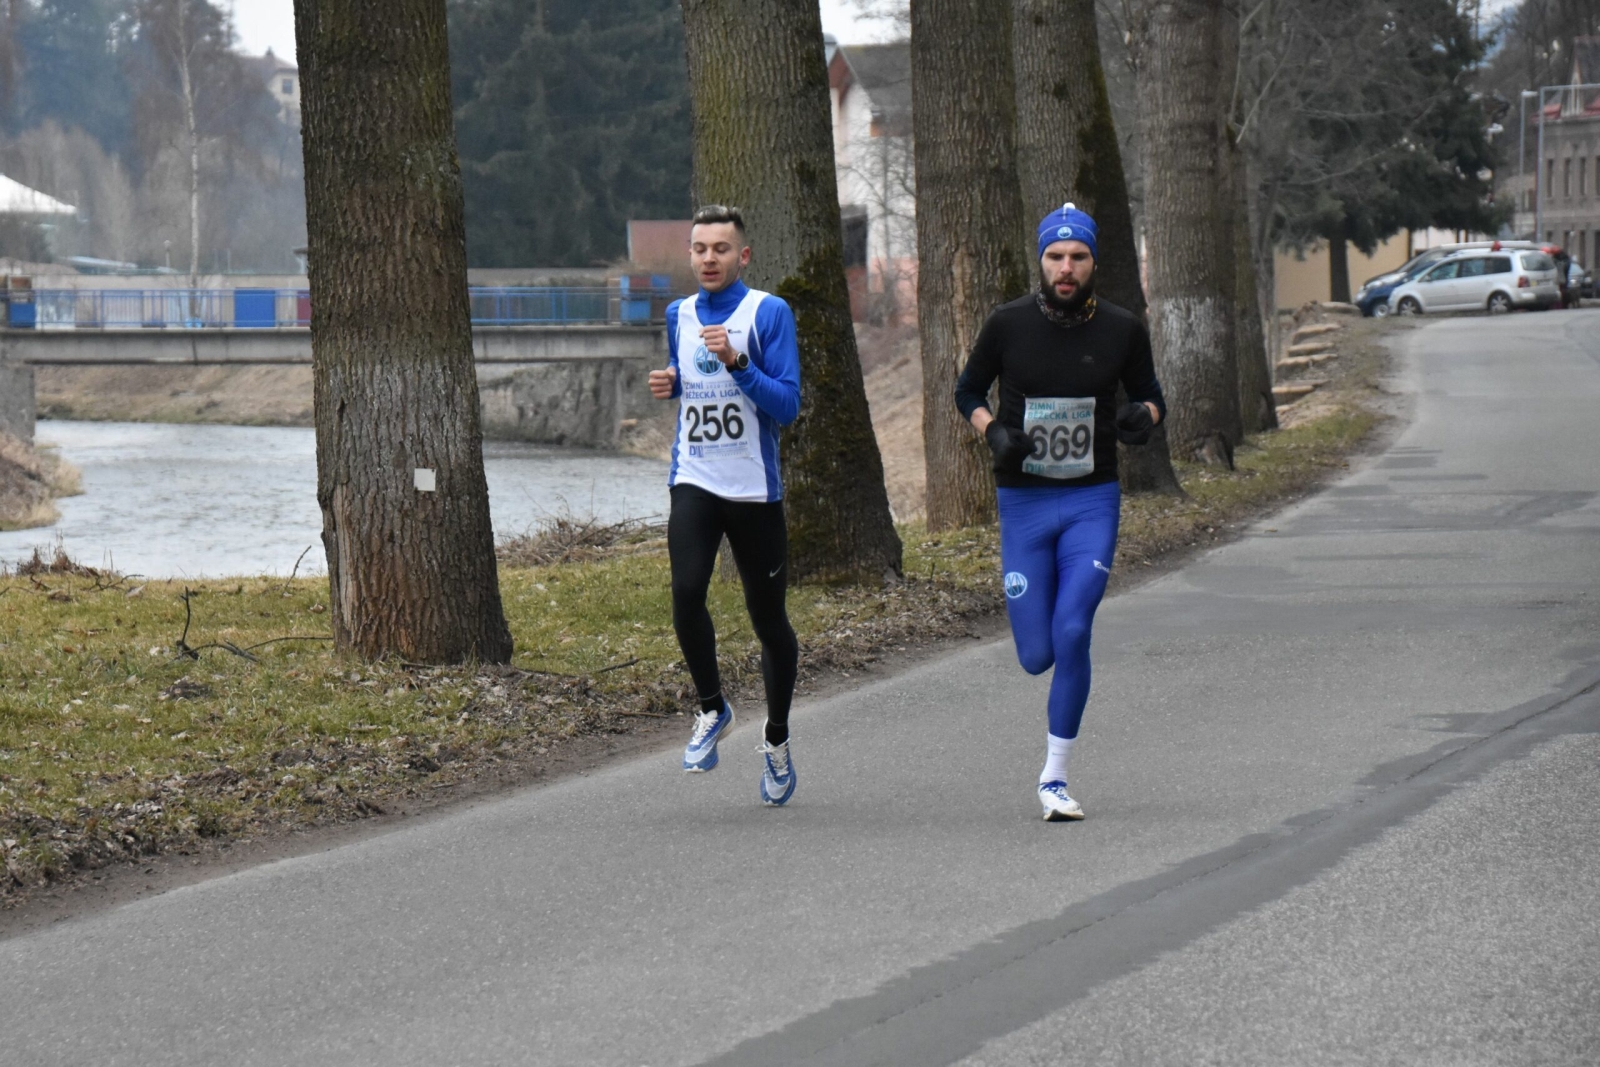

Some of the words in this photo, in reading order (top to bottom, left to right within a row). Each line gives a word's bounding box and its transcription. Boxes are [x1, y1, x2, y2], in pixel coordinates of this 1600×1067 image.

[685, 380, 704, 390] ZIMNÍ
[685, 390, 716, 399] BĚŽECKÁ
[719, 389, 741, 398] LIGA
[1029, 401, 1055, 410] ZIMNÍ
[1027, 410, 1068, 420] BĚŽECKÁ
[1072, 410, 1091, 419] LIGA
[685, 402, 744, 443] 256
[1028, 423, 1091, 461] 669
